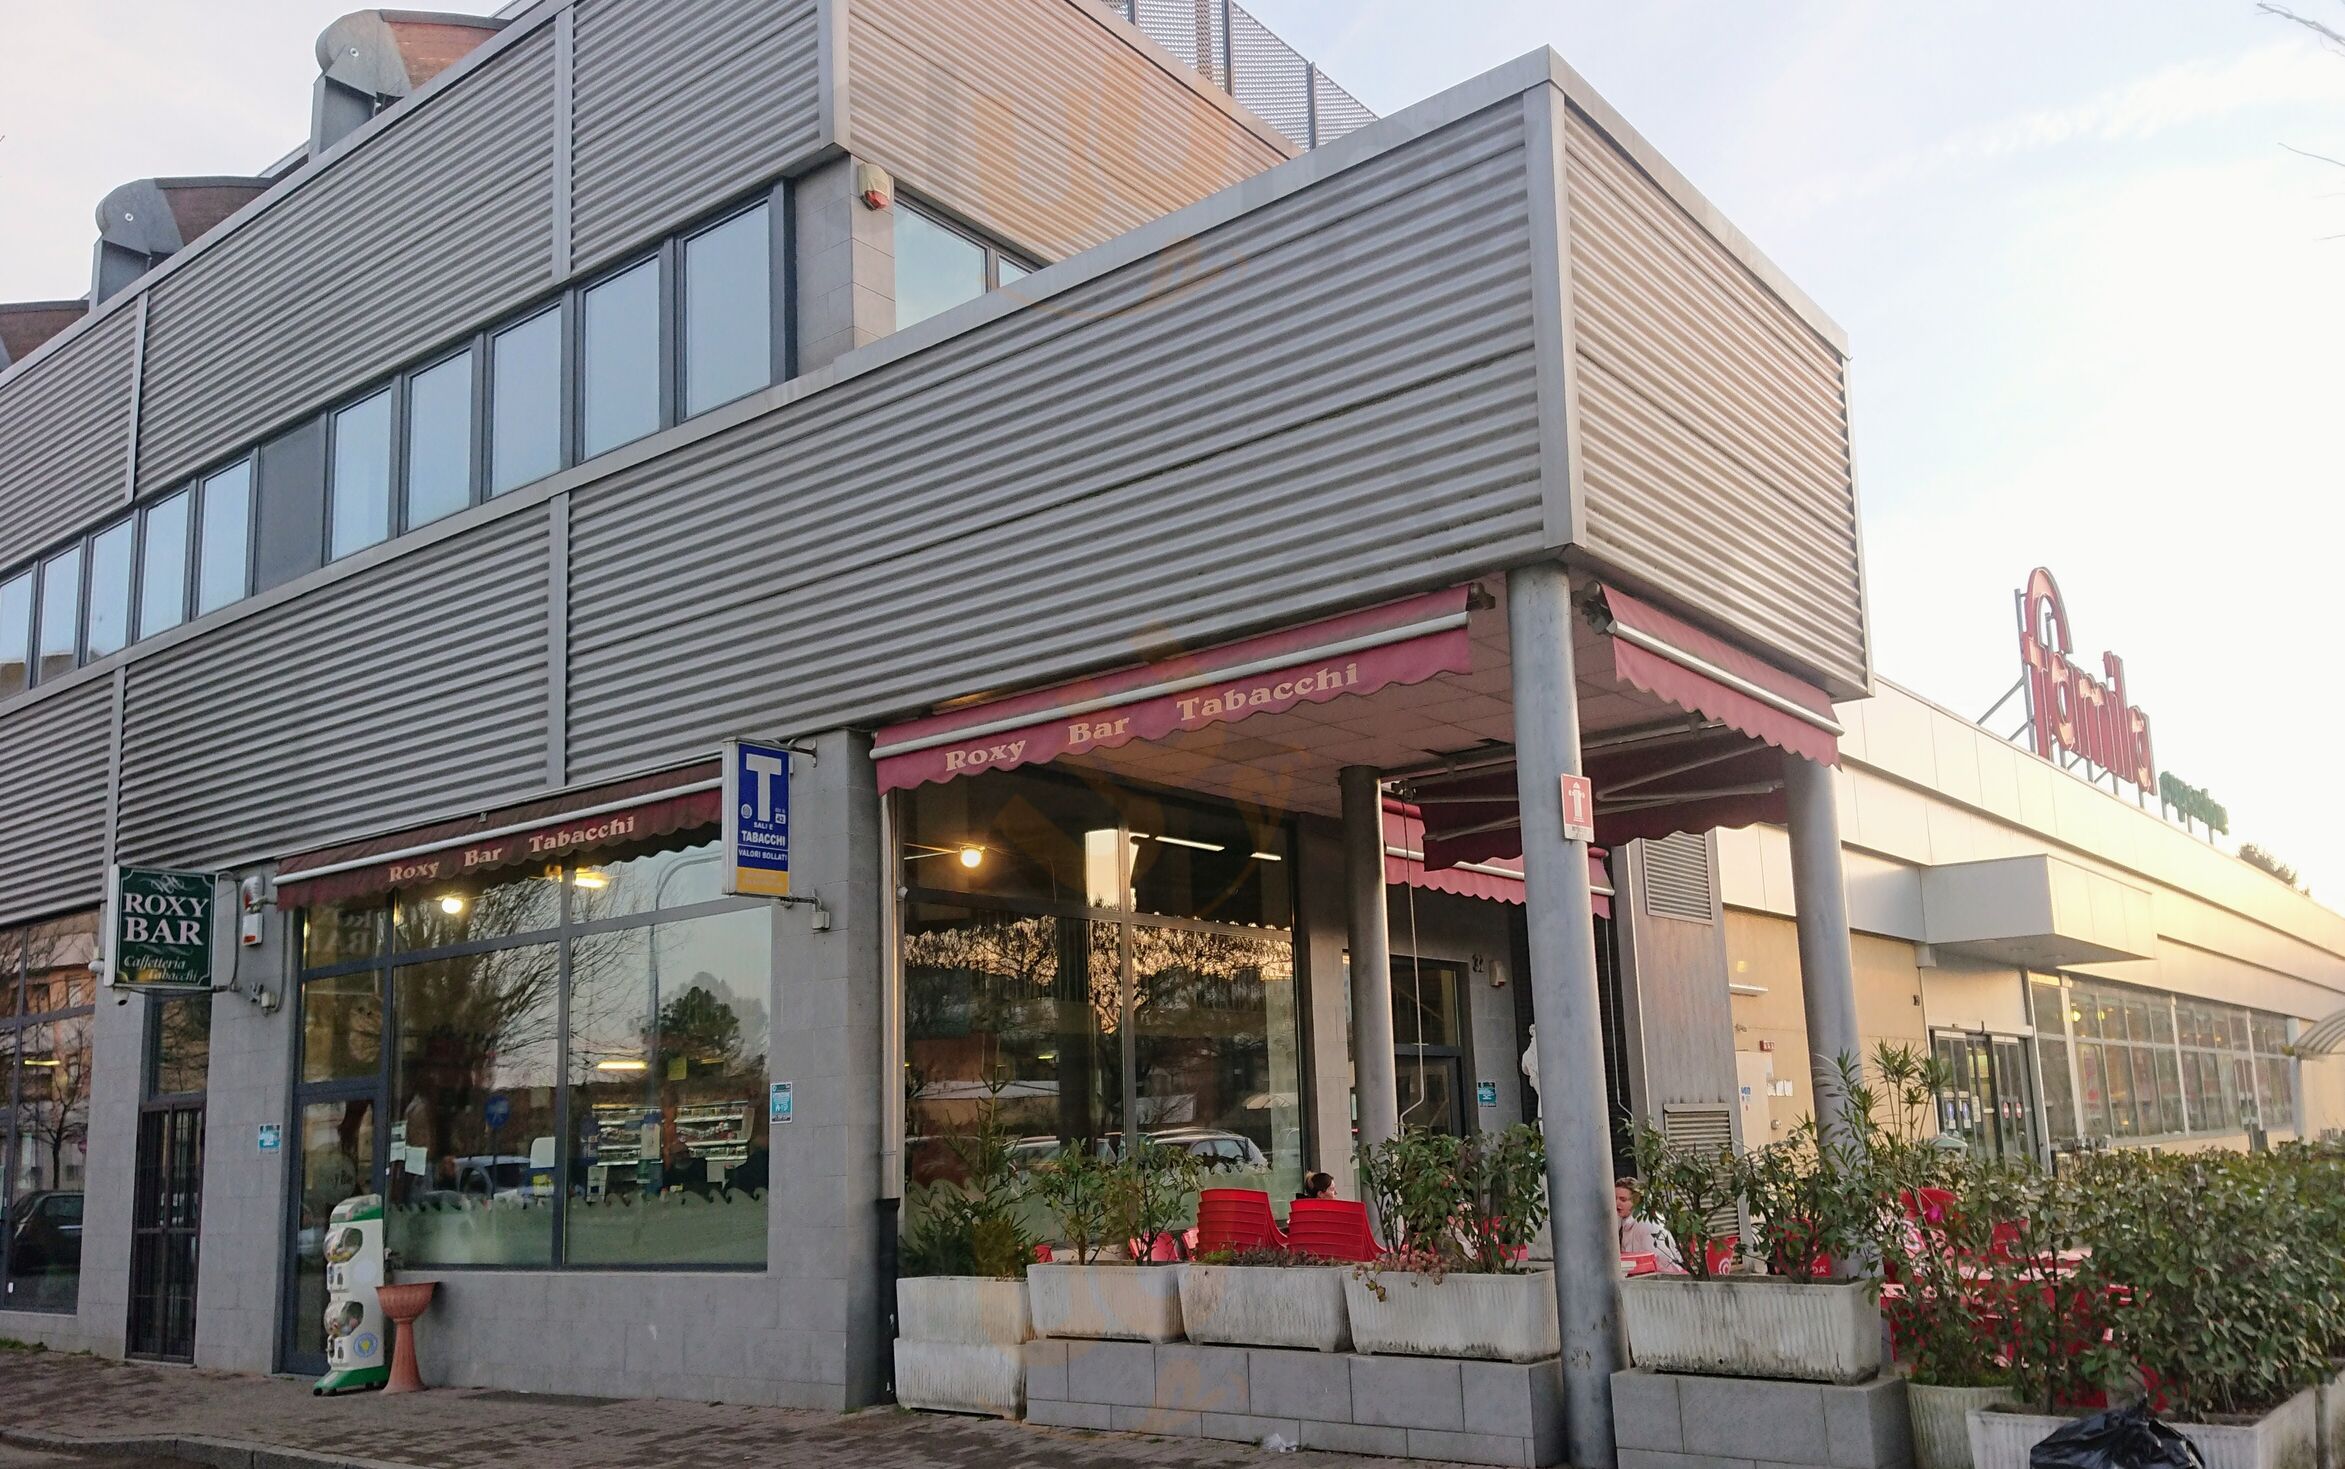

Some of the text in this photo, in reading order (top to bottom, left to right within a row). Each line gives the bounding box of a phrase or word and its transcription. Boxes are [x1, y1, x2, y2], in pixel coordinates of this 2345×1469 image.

[945, 663, 1359, 772] Roxy Bar Tabacchi
[746, 753, 782, 821] T
[753, 821, 774, 831] SALI E
[741, 830, 786, 847] TABACCHI
[389, 816, 635, 883] Roxy Bar Tabacchi
[738, 849, 788, 861] VALORI BOLLATI
[123, 893, 210, 918] ROXY
[123, 916, 205, 946] BAR
[123, 953, 186, 969] Caffetteria
[147, 968, 198, 982] Tabacchi
